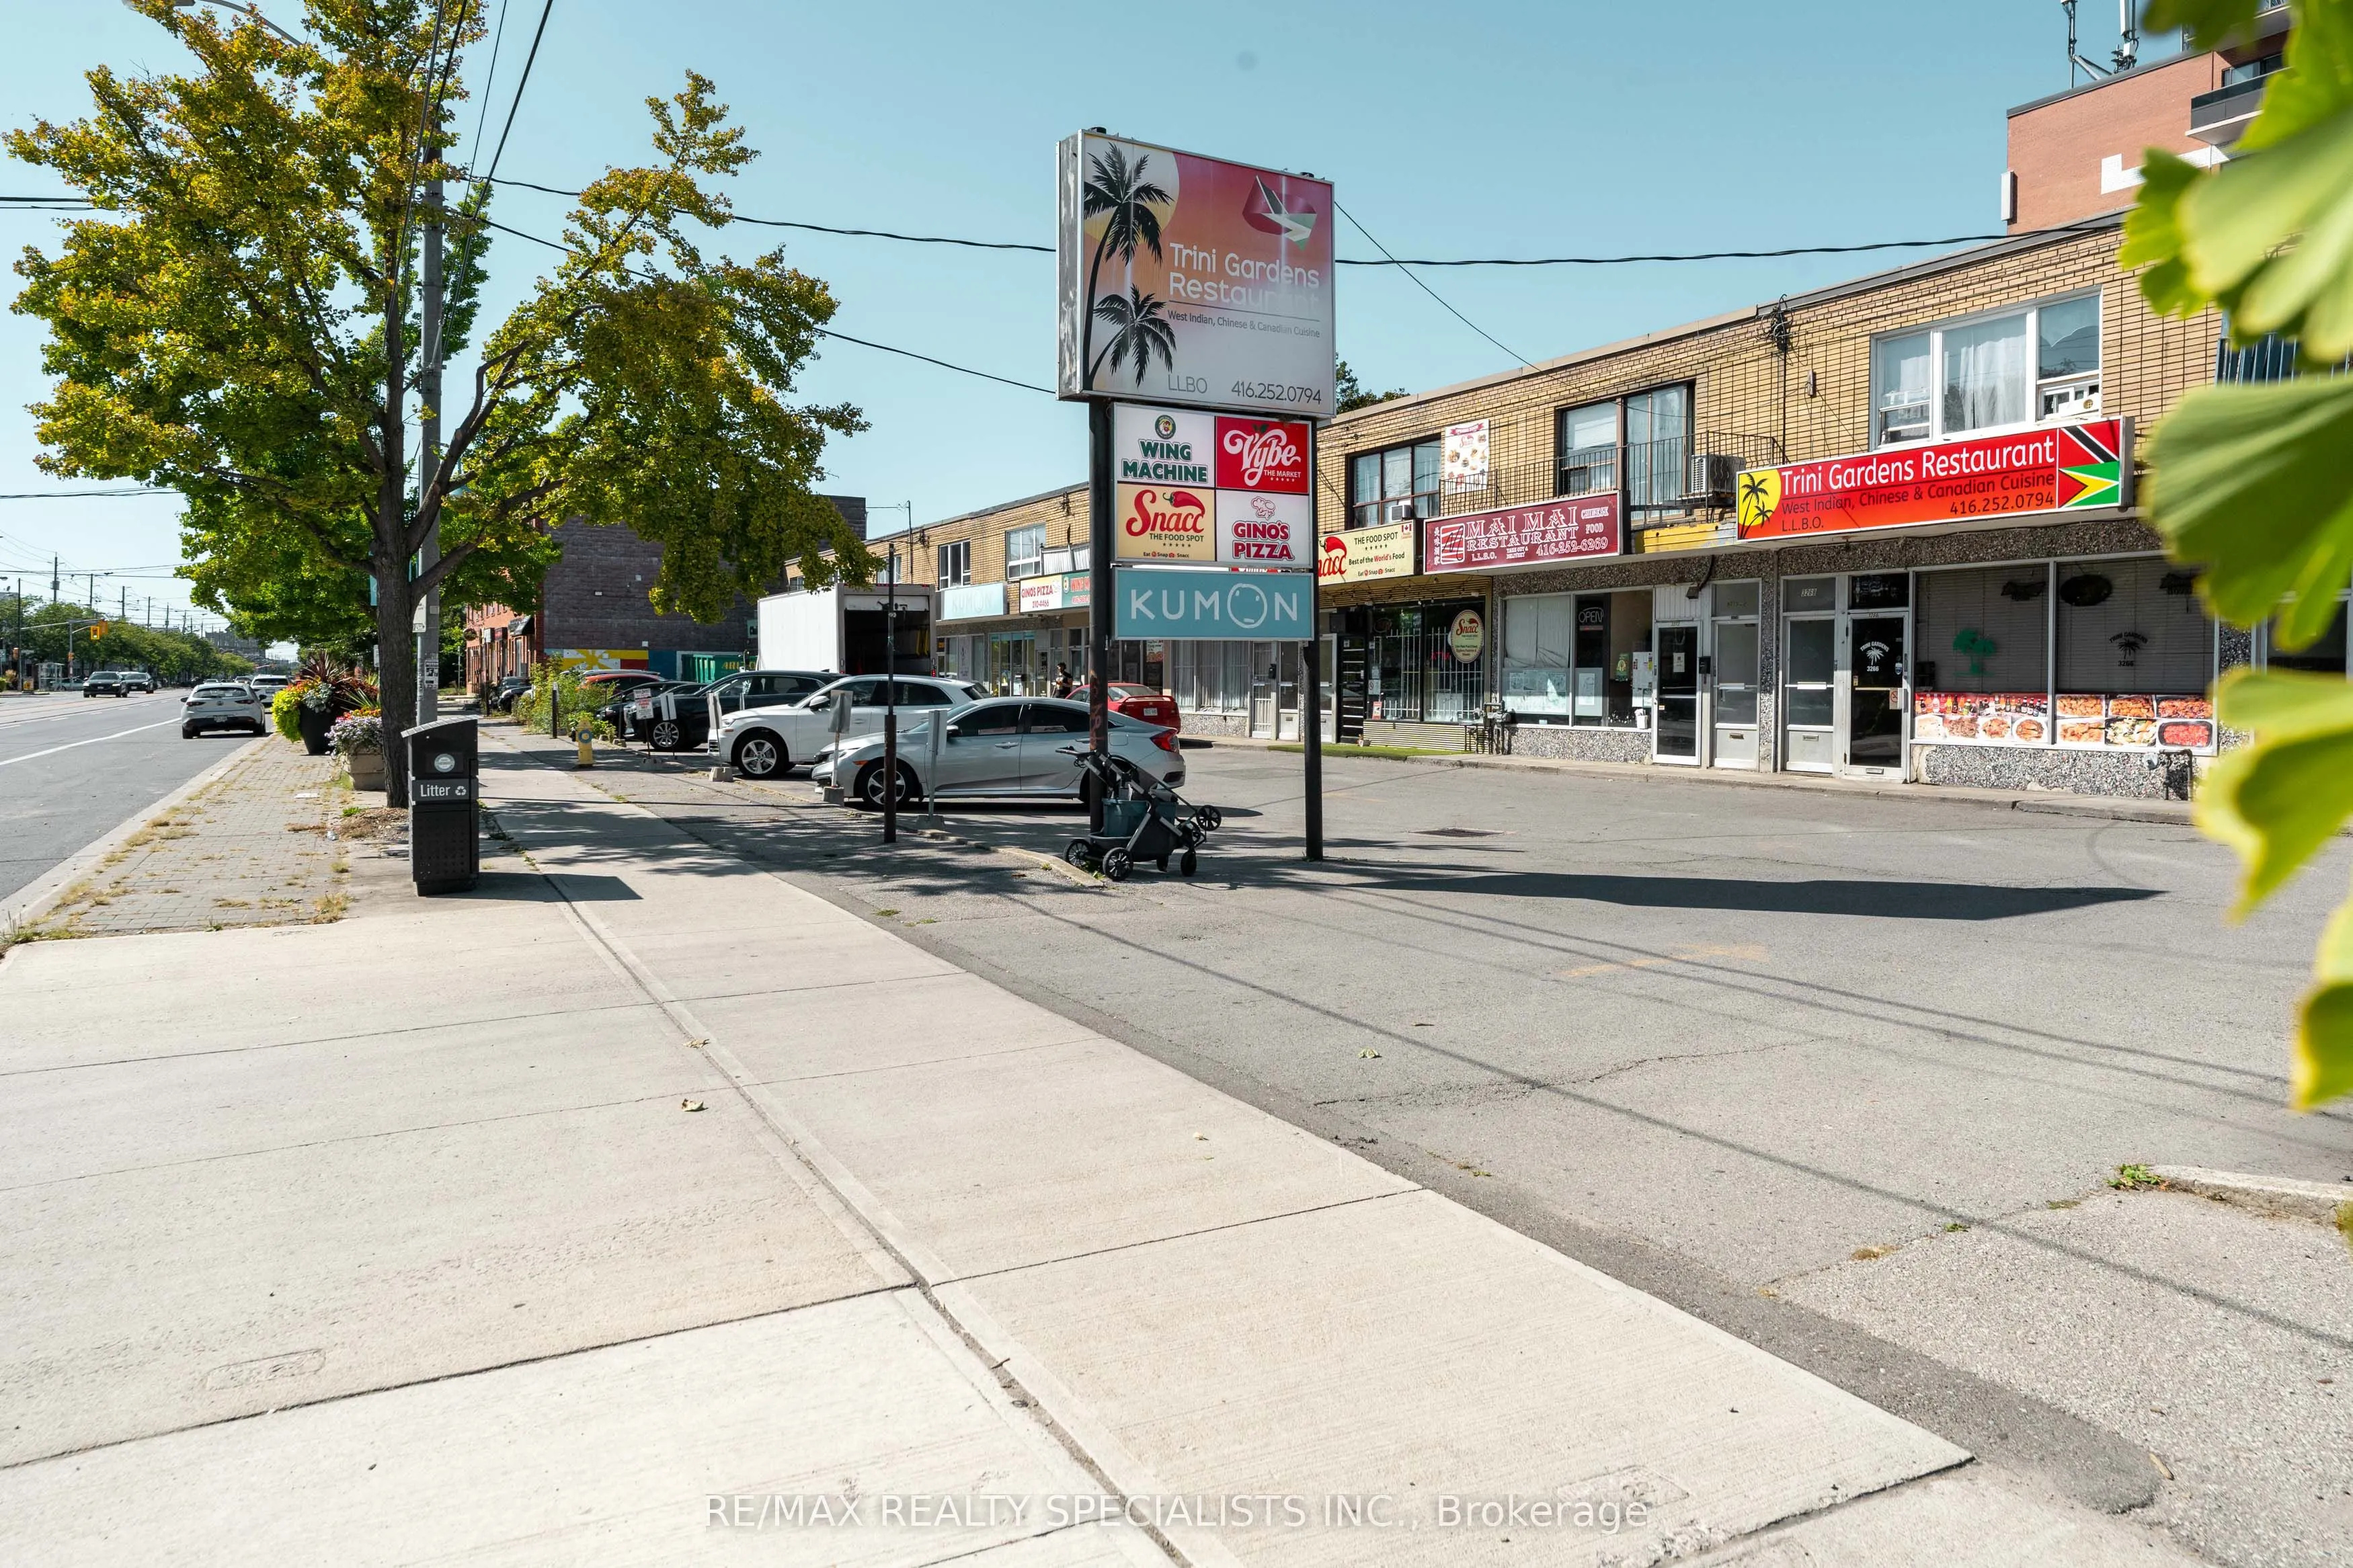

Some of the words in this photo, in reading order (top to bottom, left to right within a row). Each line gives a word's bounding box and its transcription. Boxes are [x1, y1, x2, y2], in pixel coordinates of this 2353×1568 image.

[1170, 243, 1216, 273] Trini
[1225, 253, 1320, 288] Gardens
[1170, 272, 1320, 315] Restaurnt
[1168, 310, 1188, 321] West
[1189, 312, 1215, 327] Indian,
[1218, 317, 1247, 329] Chinese
[1250, 322, 1257, 330] &
[1258, 323, 1292, 335] Canadian
[1293, 327, 1320, 338] Cuisine
[1168, 374, 1207, 393] LLBO
[1232, 380, 1322, 405] 416.252.0794
[1140, 440, 1192, 462] WING
[1224, 429, 1302, 487] Vybe
[1122, 460, 1208, 483] MACHINE
[1782, 465, 1823, 495] Trini
[1829, 458, 1914, 490] Gardens
[1923, 436, 2055, 479] Restaurant
[1782, 502, 1810, 514] West
[1815, 495, 1856, 511] Indian,
[1860, 491, 1909, 507] Chinese
[1914, 486, 1923, 500] &
[1928, 480, 1995, 499] Canadian
[2001, 472, 2055, 491] Cuisine
[1950, 491, 2054, 515] 416.252.0794
[1125, 489, 1205, 536] Snacc
[1466, 515, 1517, 540] MAI
[1521, 507, 1579, 532] MAI
[1782, 516, 1824, 532] L.L.B.O.
[1233, 520, 1290, 540] GINO'S
[1366, 534, 1382, 544] FOOD
[1384, 532, 1398, 541] SPOT
[1467, 526, 1579, 552] RESTAURANT
[1585, 523, 1604, 534] FOOD
[1233, 541, 1294, 561] PIZZA
[1374, 554, 1392, 563] World's
[1392, 551, 1405, 559] Food
[1536, 537, 1609, 556] 416-252-6269
[1318, 554, 1347, 577] nacc
[1021, 586, 1035, 597] GINO'S
[1037, 585, 1053, 596] PIZZA
[1131, 583, 1298, 629] KUMON
[1579, 611, 1602, 623] OPEN
[1871, 641, 1890, 652] GARDENS
[420, 784, 450, 797] Litter
